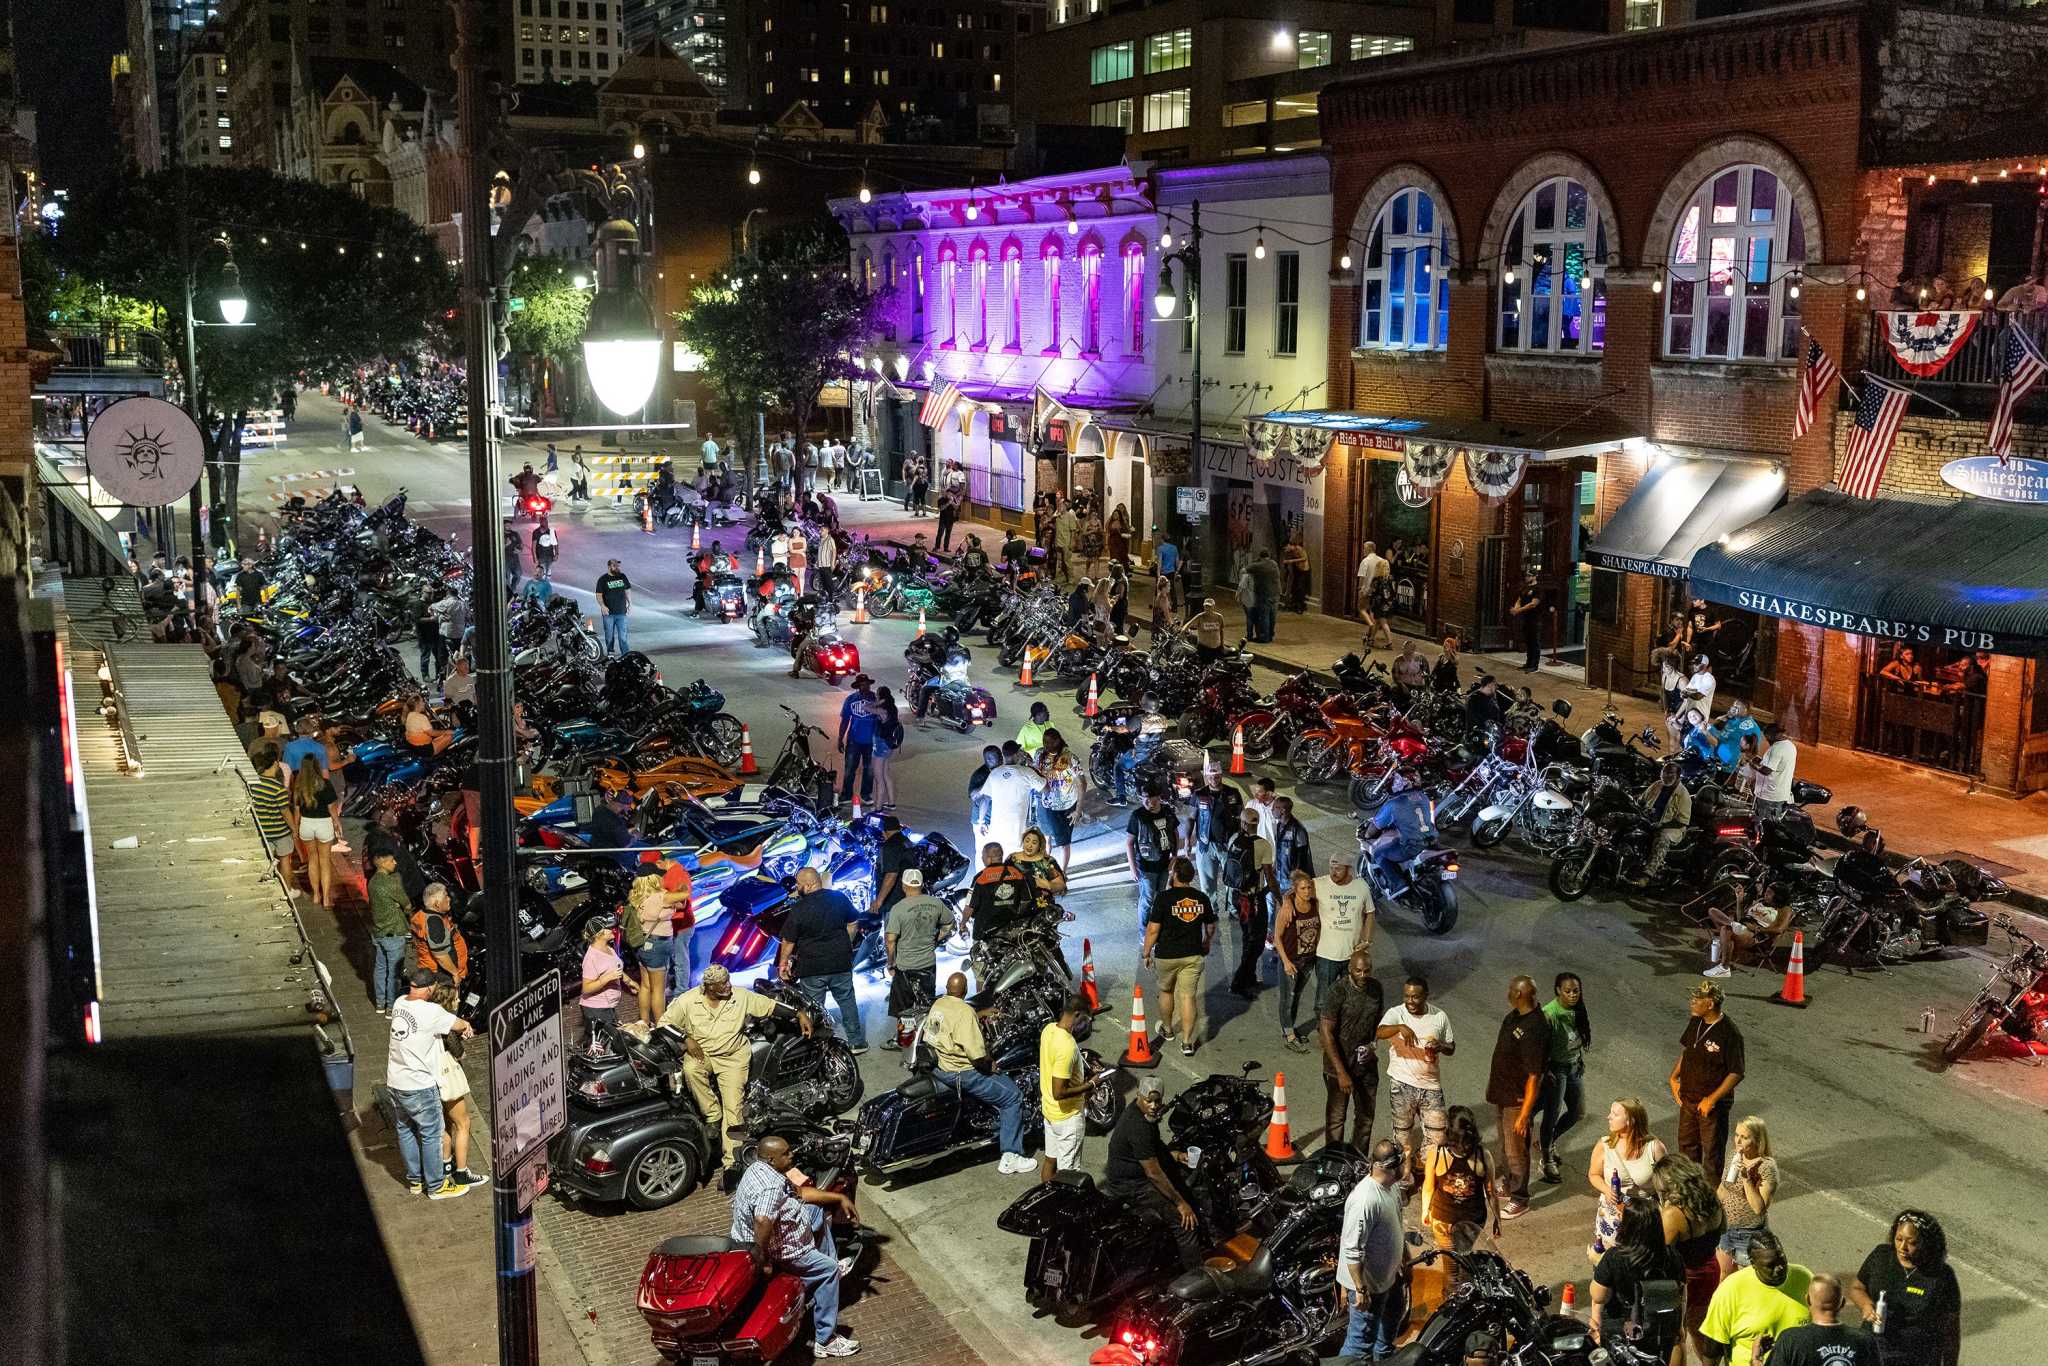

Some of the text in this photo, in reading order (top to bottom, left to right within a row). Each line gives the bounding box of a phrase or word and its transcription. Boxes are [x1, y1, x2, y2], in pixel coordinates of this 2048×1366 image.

[1339, 432, 1393, 449] Ride The Bull
[1200, 443, 1238, 473] IZZY
[1601, 554, 1678, 577] SHAKESPEARE'S
[1738, 591, 1995, 650] SHAKESPEARE'S PUB
[507, 978, 558, 1021] RESTRICTED
[522, 1004, 544, 1030] LANE
[1136, 1038, 1145, 1052] A
[497, 1044, 559, 1101] LOADING AND
[504, 1072, 555, 1121] UNLODING
[1282, 1131, 1290, 1149] A
[1816, 1344, 1856, 1359] Dirty's
